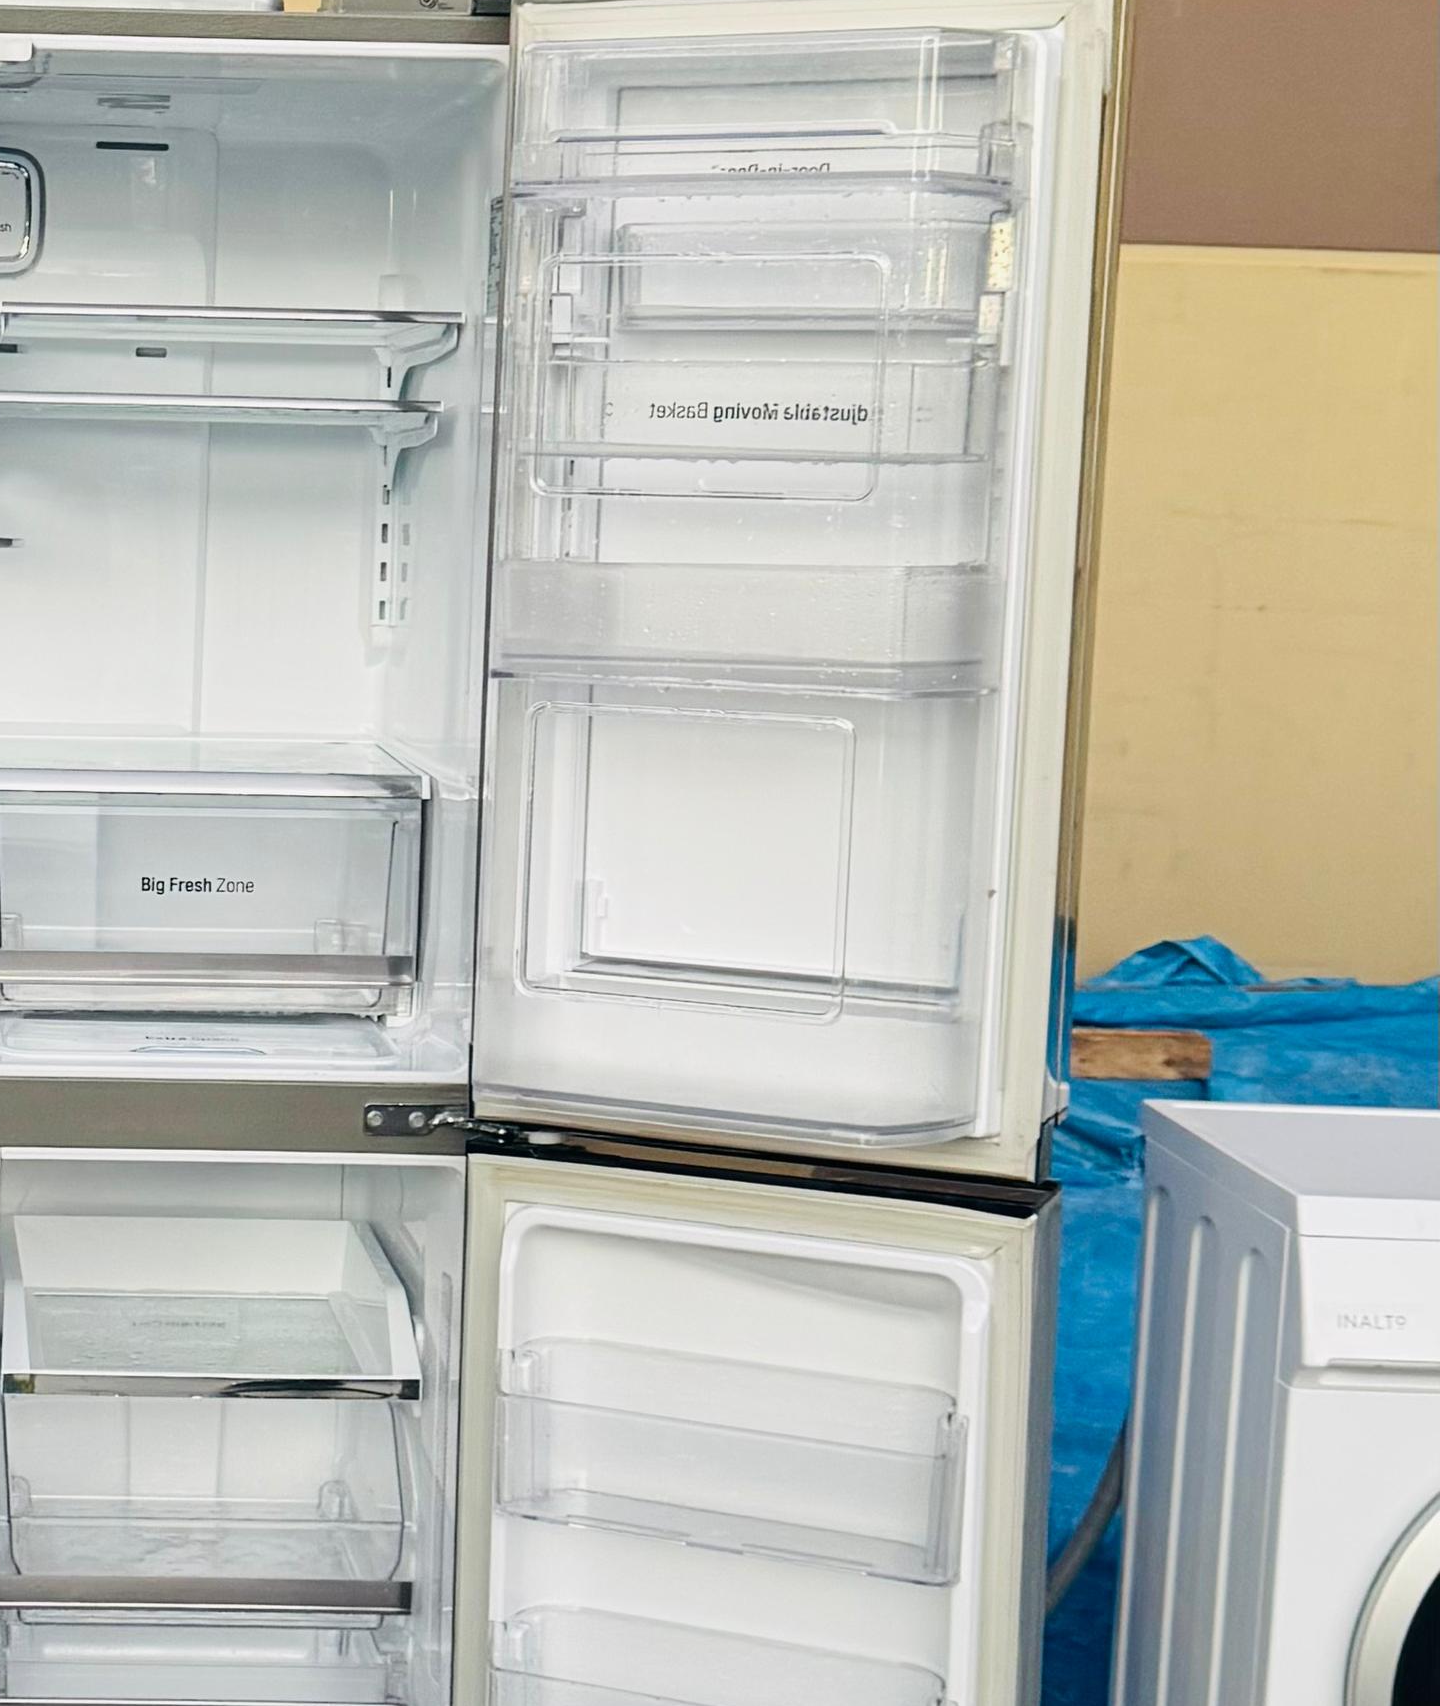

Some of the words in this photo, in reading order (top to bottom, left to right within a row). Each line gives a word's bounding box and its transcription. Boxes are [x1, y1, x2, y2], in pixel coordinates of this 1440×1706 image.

[141, 876, 165, 895] Big
[170, 877, 212, 892] Fresh
[216, 877, 255, 893] Zone
